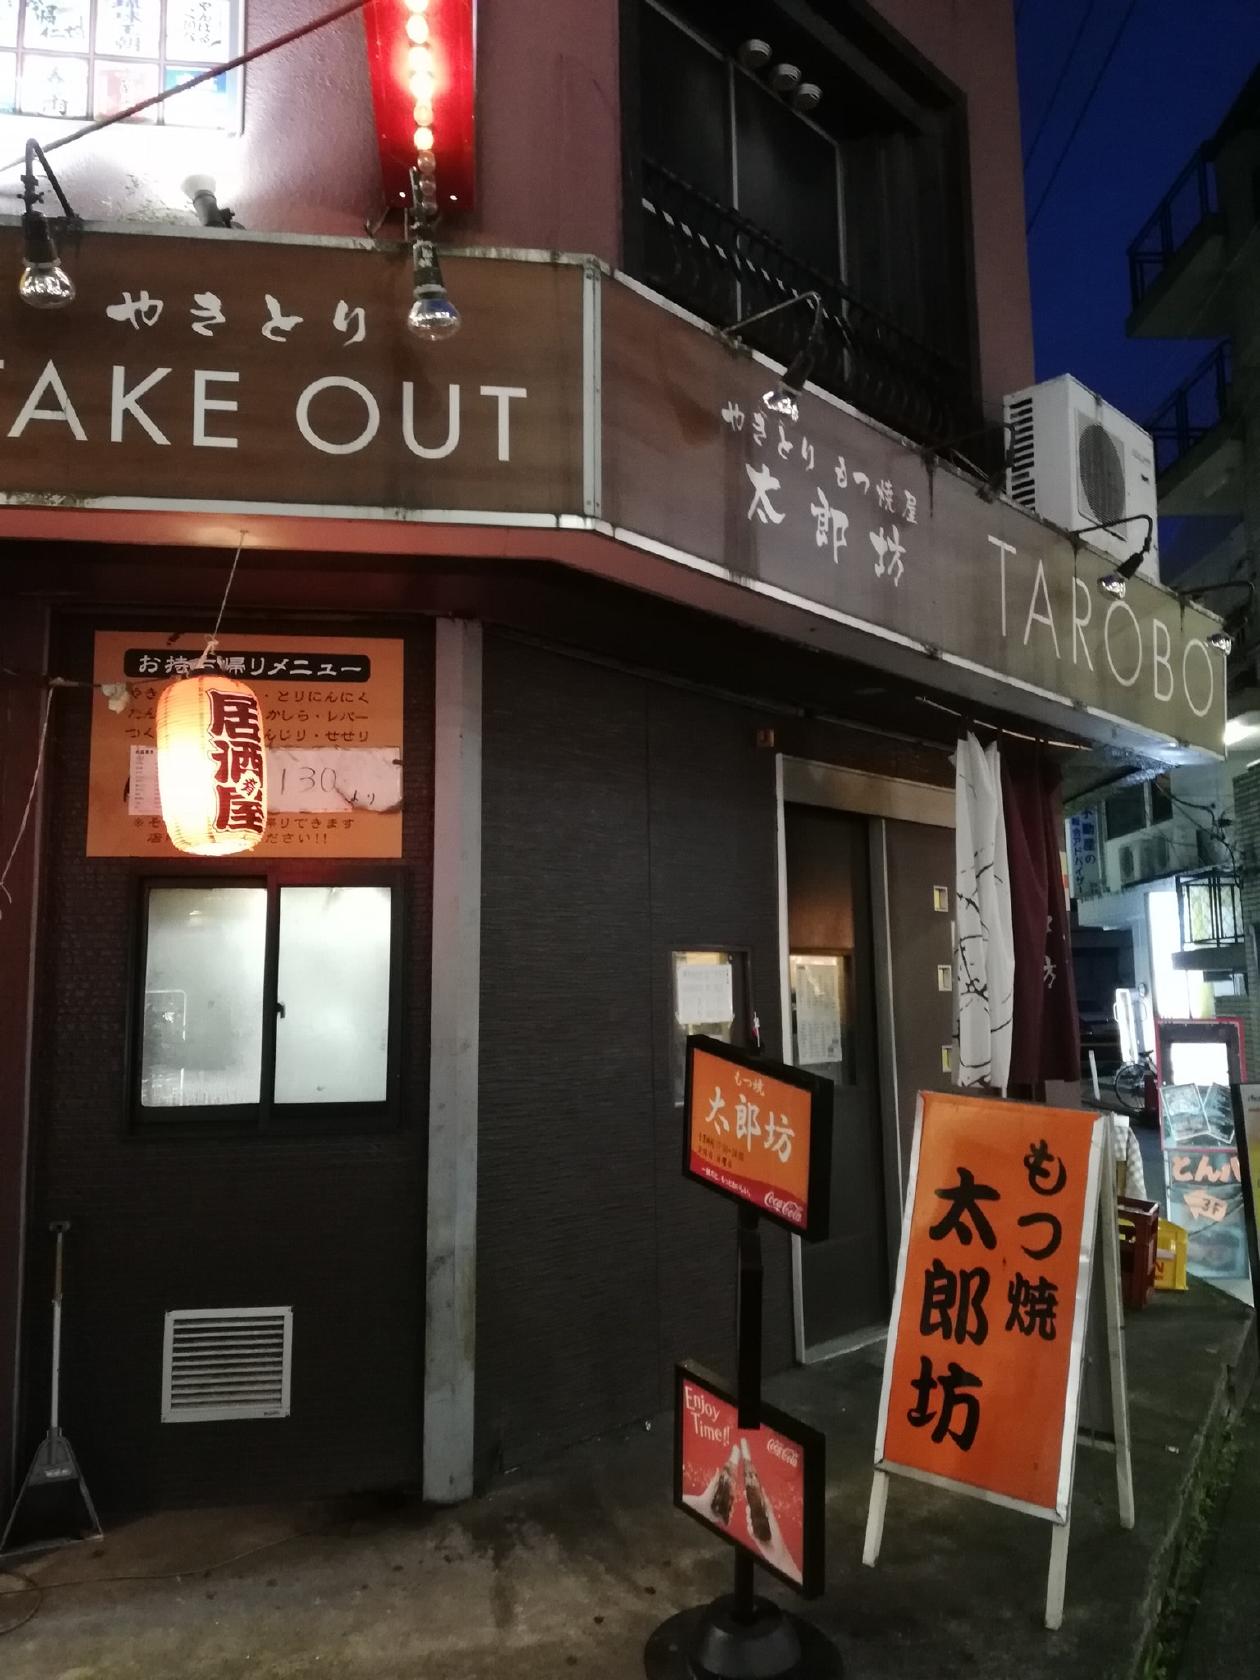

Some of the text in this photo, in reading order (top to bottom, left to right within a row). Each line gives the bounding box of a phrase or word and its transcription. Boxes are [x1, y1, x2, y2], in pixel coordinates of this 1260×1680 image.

[107, 290, 367, 346] やきとり
[0, 359, 528, 462] AKE OUT
[721, 400, 918, 524] やきとり もつ焼屋
[745, 462, 907, 588] 太郎坊
[987, 534, 1214, 717] TAROBO
[207, 689, 264, 834] 居酒屋
[705, 1086, 796, 1164] 太郎坊
[1004, 1138, 1068, 1342] もつ焼
[907, 1166, 1001, 1453] 太郎坊
[684, 1384, 721, 1423] Enjoy
[689, 1410, 731, 1447] Time!!
